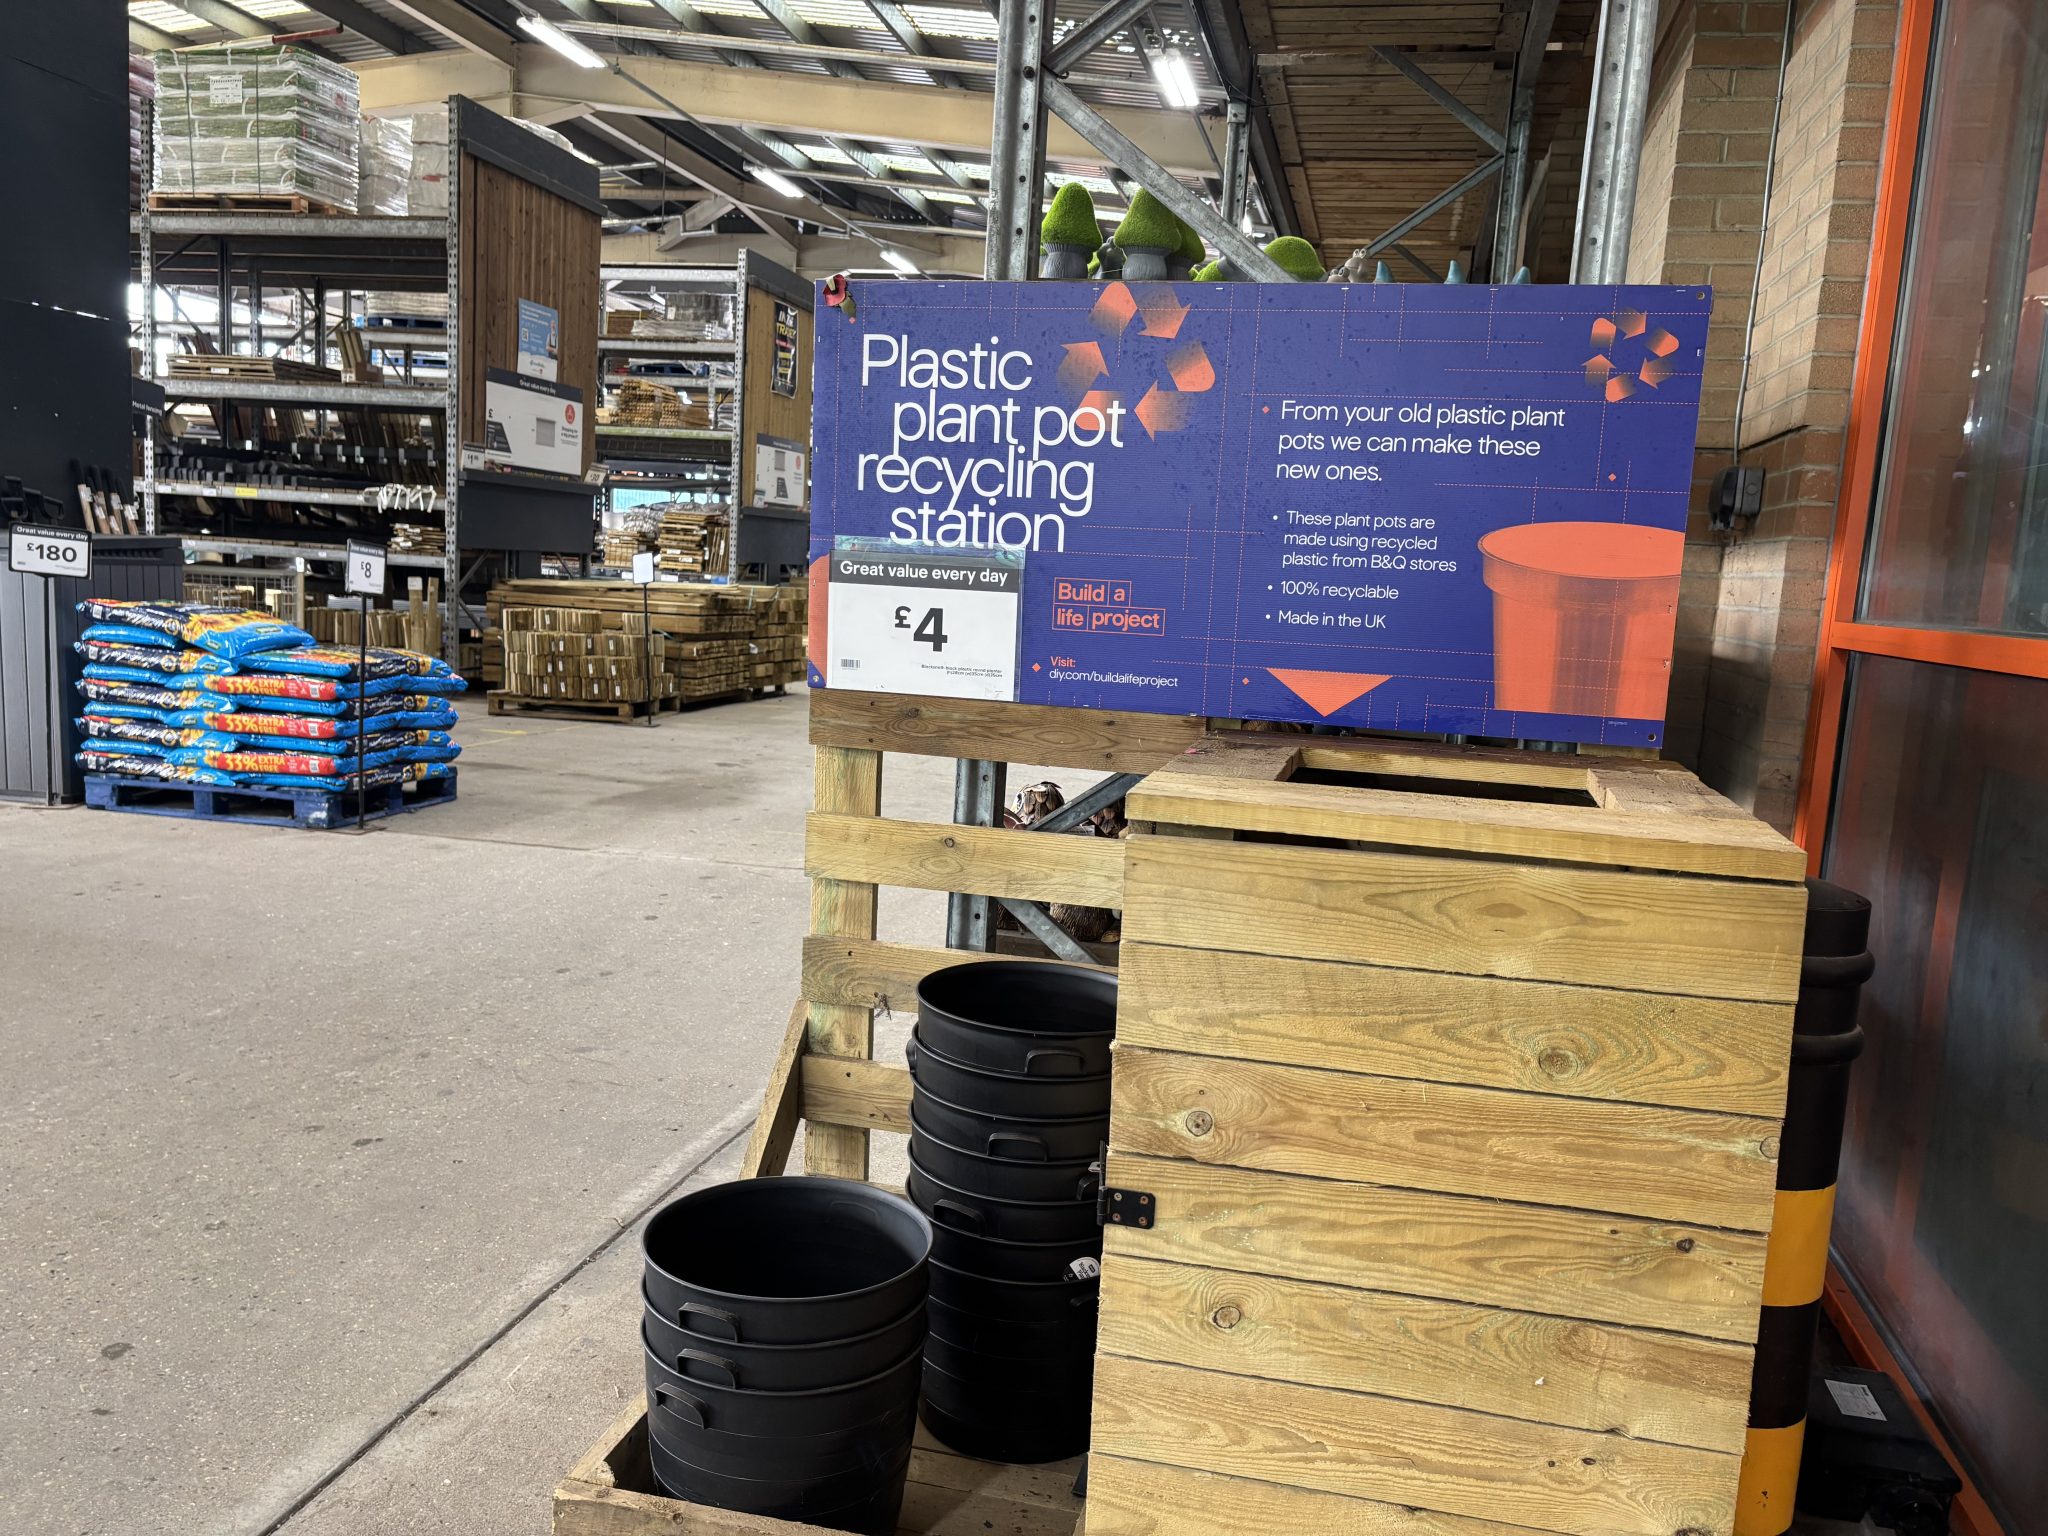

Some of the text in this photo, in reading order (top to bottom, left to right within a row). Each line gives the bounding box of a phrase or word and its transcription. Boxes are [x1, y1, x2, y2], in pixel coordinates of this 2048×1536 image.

[862, 333, 1033, 390] Plastic
[132, 401, 145, 410] Metal
[1282, 400, 1565, 430] From your old plastic plant
[893, 390, 1126, 460] plant pot
[1279, 433, 1540, 456] pots we can make these
[857, 446, 1094, 517] recycling
[1277, 464, 1382, 481] new ones.
[890, 499, 1064, 552] station
[1287, 511, 1435, 530] These plant pots are
[17, 526, 88, 541] Great value every day
[1284, 532, 1437, 552] made using recycled
[27, 542, 77, 562] £180
[1283, 552, 1457, 572] plastic from B&Q stores
[361, 561, 371, 578] £8
[840, 560, 1008, 587] Great value every day
[1056, 583, 1125, 604] Build a
[1281, 581, 1398, 600] 100% recyclable
[895, 606, 948, 652] £4
[1057, 608, 1160, 634] life project
[1279, 610, 1385, 628] Made in the UK
[1051, 656, 1075, 667] Visit:
[226, 678, 285, 693] 33% EXTRA
[1050, 669, 1177, 688] diy.com/buildalifeproject
[225, 717, 285, 733] 33% EXTRA
[225, 754, 285, 770] 33% EXTRA
